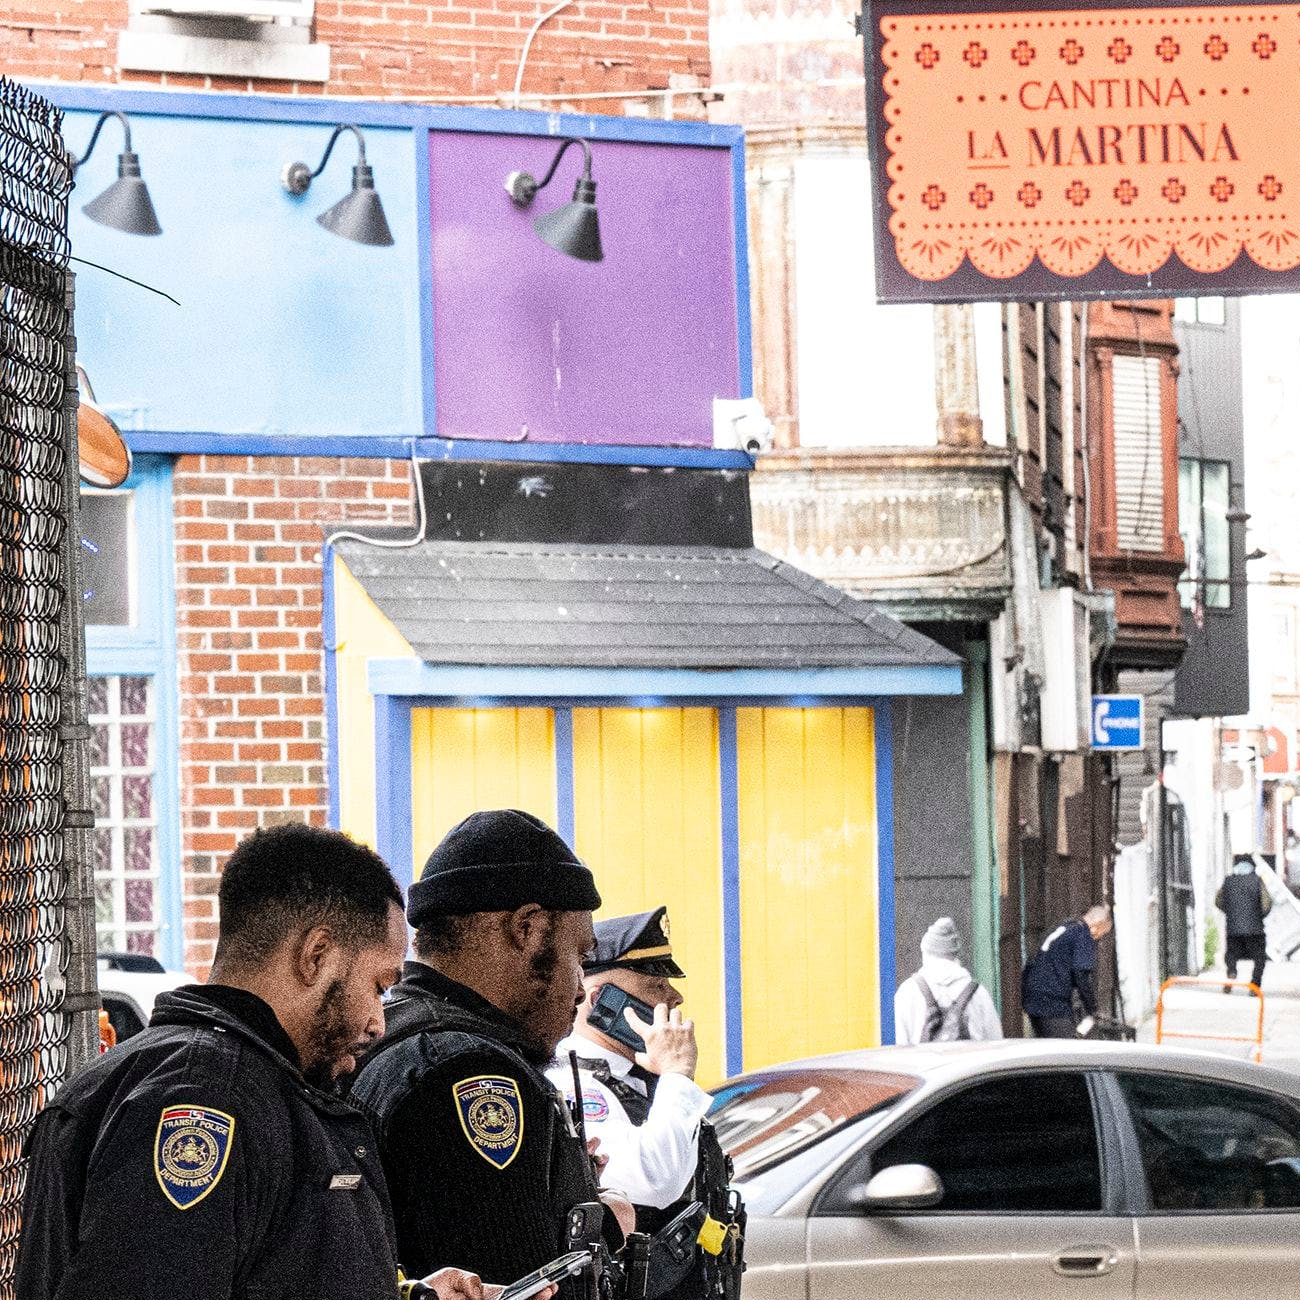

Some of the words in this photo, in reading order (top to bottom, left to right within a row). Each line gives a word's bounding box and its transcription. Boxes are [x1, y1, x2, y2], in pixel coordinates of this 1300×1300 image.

[1018, 77, 1191, 112] CANTINA
[967, 130, 1008, 160] LA
[1027, 122, 1241, 167] MARTINA
[460, 1088, 489, 1101] TRANSIT
[491, 1089, 516, 1098] POLICE
[163, 1119, 198, 1129] TRANSIT
[199, 1121, 228, 1136] POLICE
[473, 1132, 519, 1150] DEPARTMENT
[159, 1168, 214, 1187] DEPARTMENT
